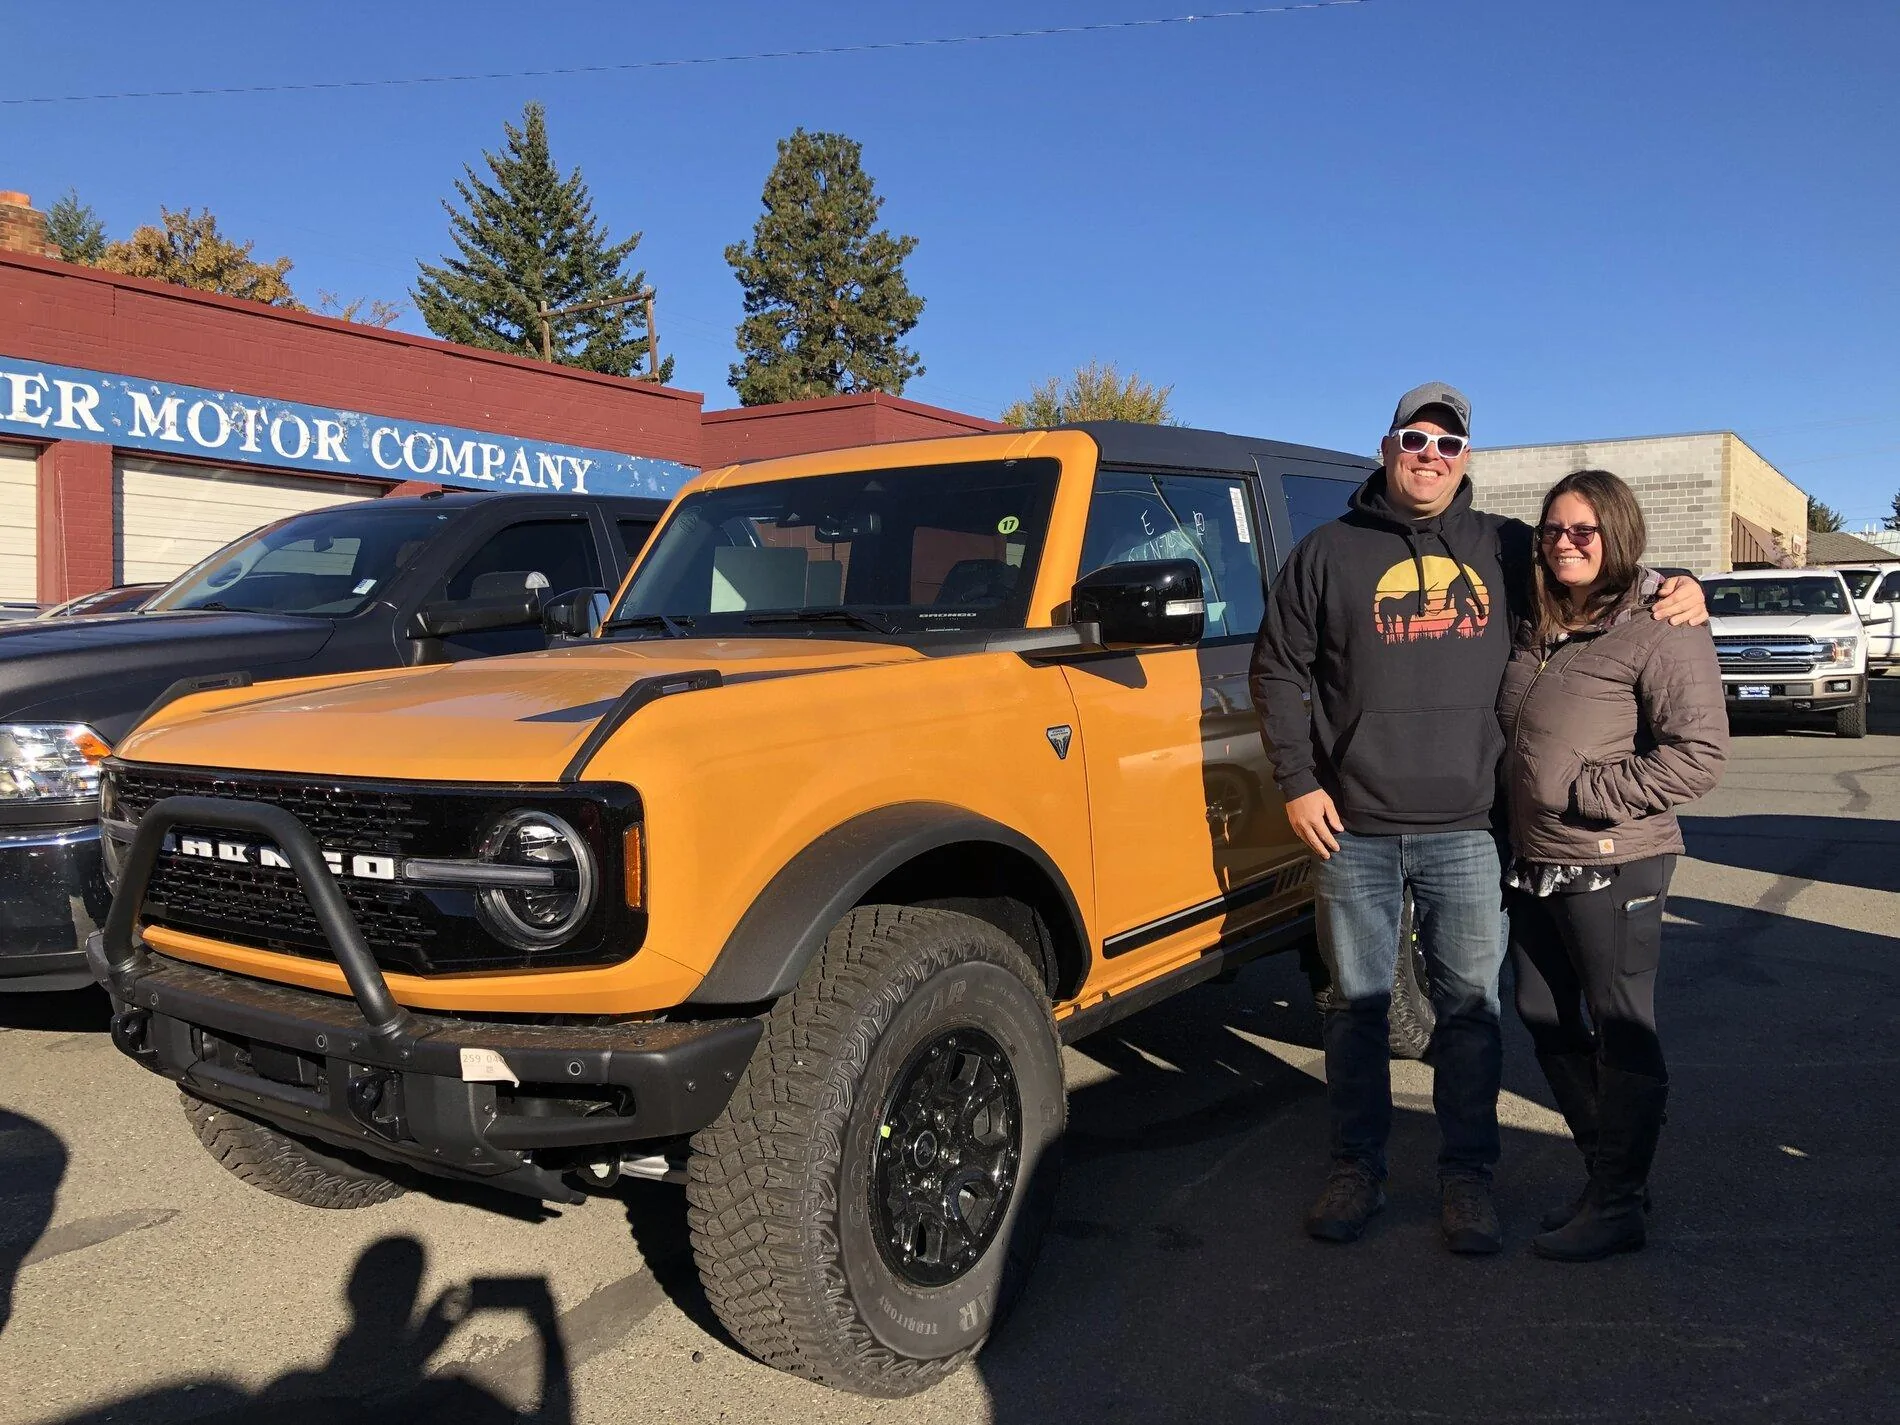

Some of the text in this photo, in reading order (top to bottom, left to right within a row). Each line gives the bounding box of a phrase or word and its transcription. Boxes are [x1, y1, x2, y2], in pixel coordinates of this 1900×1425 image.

[0, 371, 592, 494] ER MOTOR COMPANY
[1002, 519, 1016, 531] 17
[462, 1054, 481, 1063] 259
